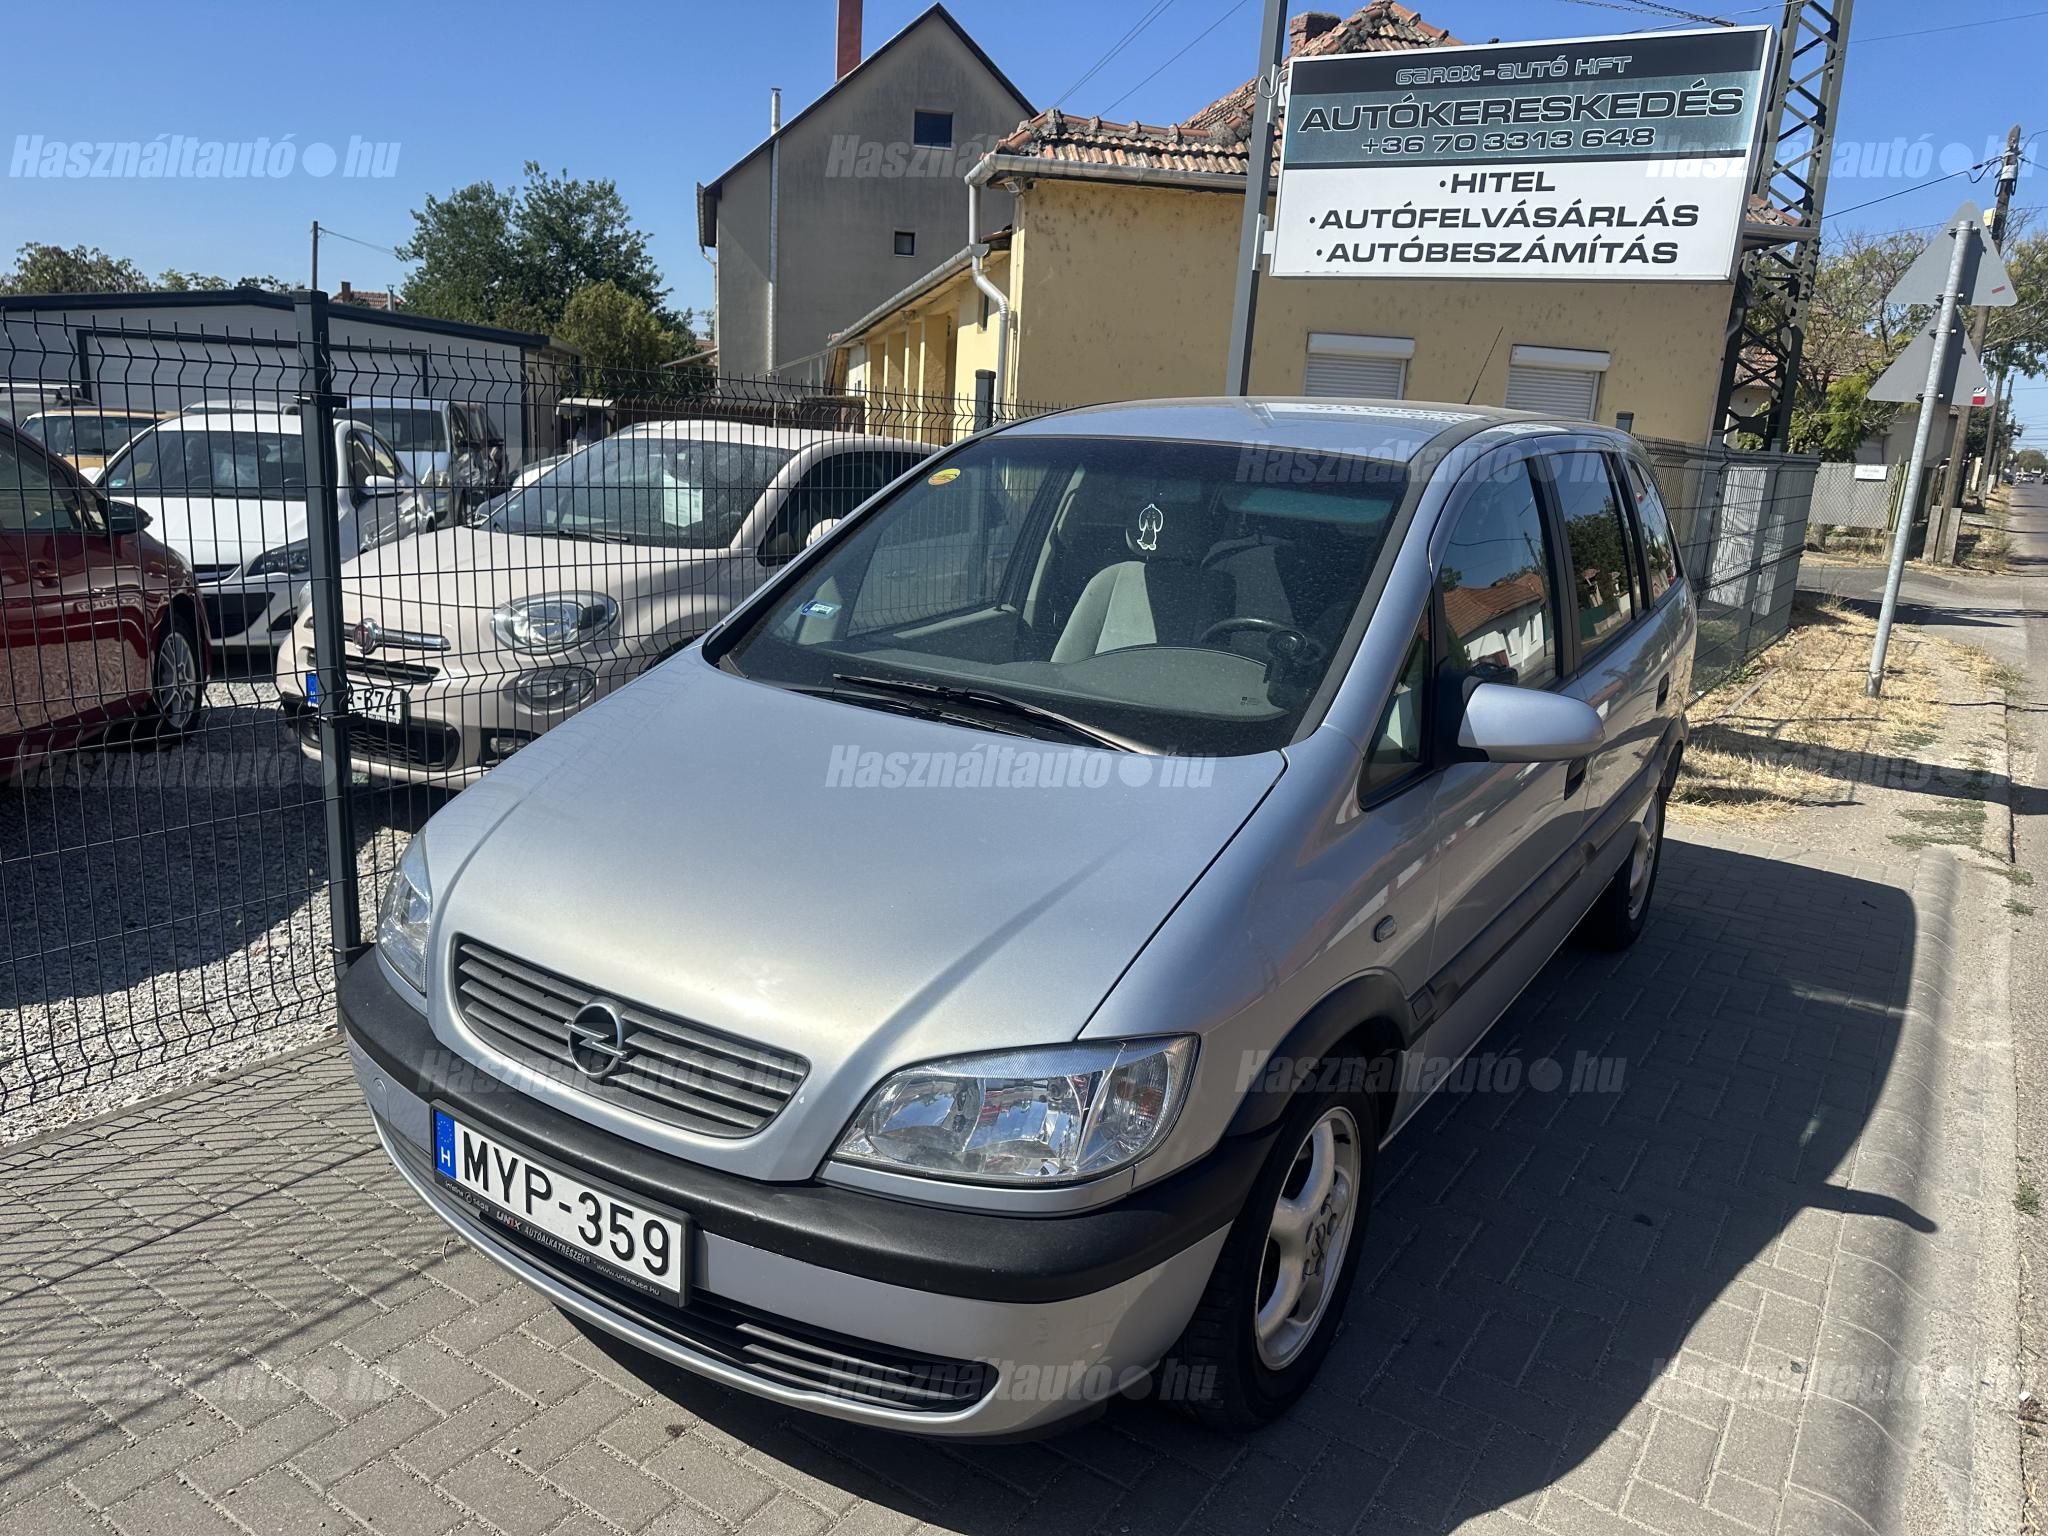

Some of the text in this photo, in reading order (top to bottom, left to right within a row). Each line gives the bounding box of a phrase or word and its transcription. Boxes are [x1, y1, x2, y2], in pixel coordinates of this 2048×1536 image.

[1298, 79, 1745, 133] AUTÓKERESKEDÉS
[1362, 127, 1656, 155] +36 70 3313 648
[1319, 197, 1700, 229] AUTÓFELVÁSÁRLÁS
[1326, 234, 1678, 264] AUTÓBESZÁMÍTÁS
[440, 1131, 669, 1276] H MYP-359
